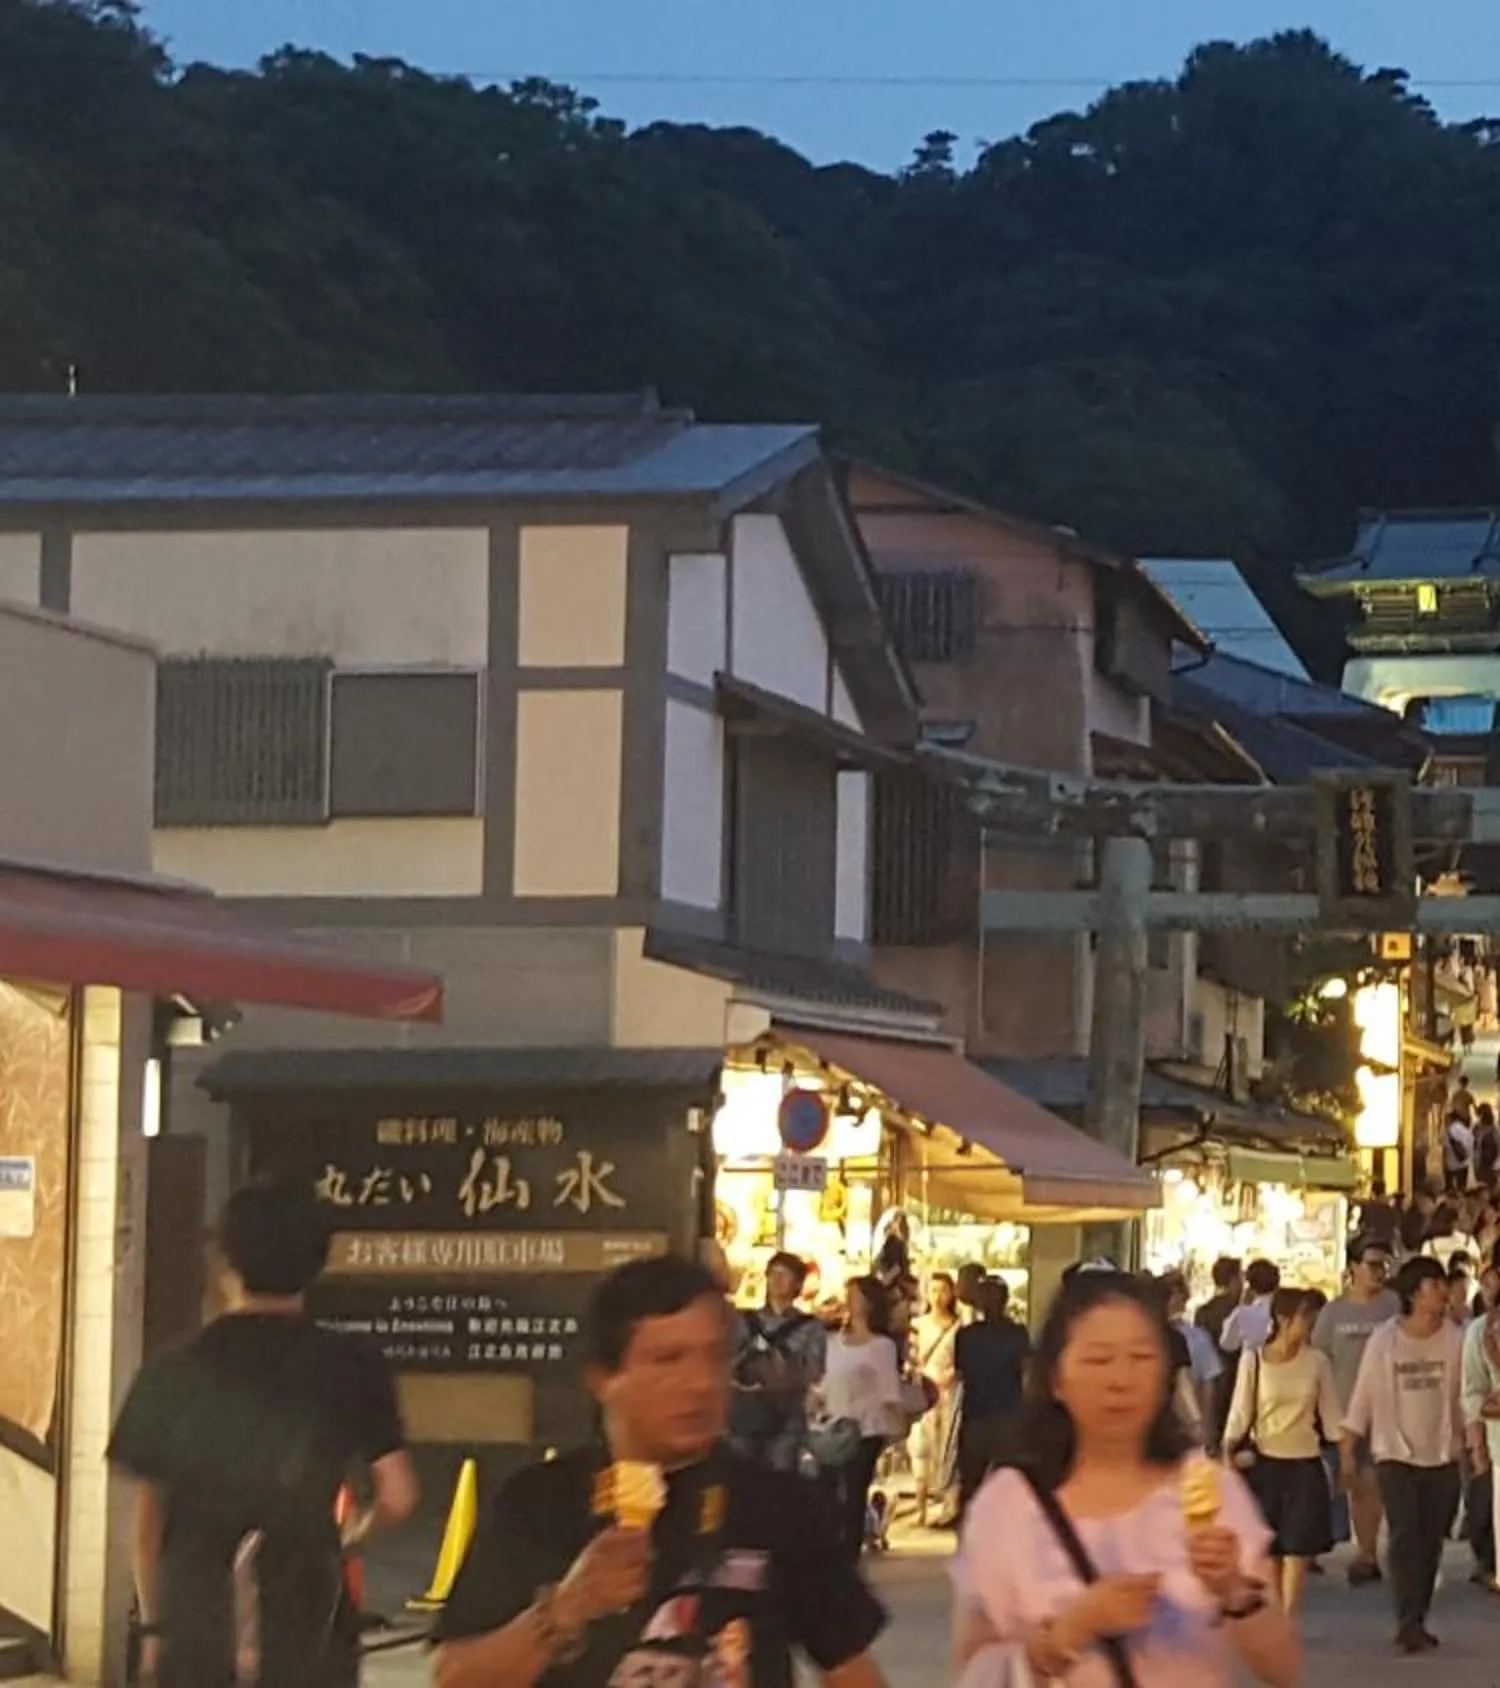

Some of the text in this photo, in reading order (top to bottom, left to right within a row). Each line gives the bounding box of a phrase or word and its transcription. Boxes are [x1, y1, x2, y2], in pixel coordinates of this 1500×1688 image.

[314, 1147, 627, 1217] 丸だい 仙水
[346, 1238, 565, 1267] お客様専用駐車場
